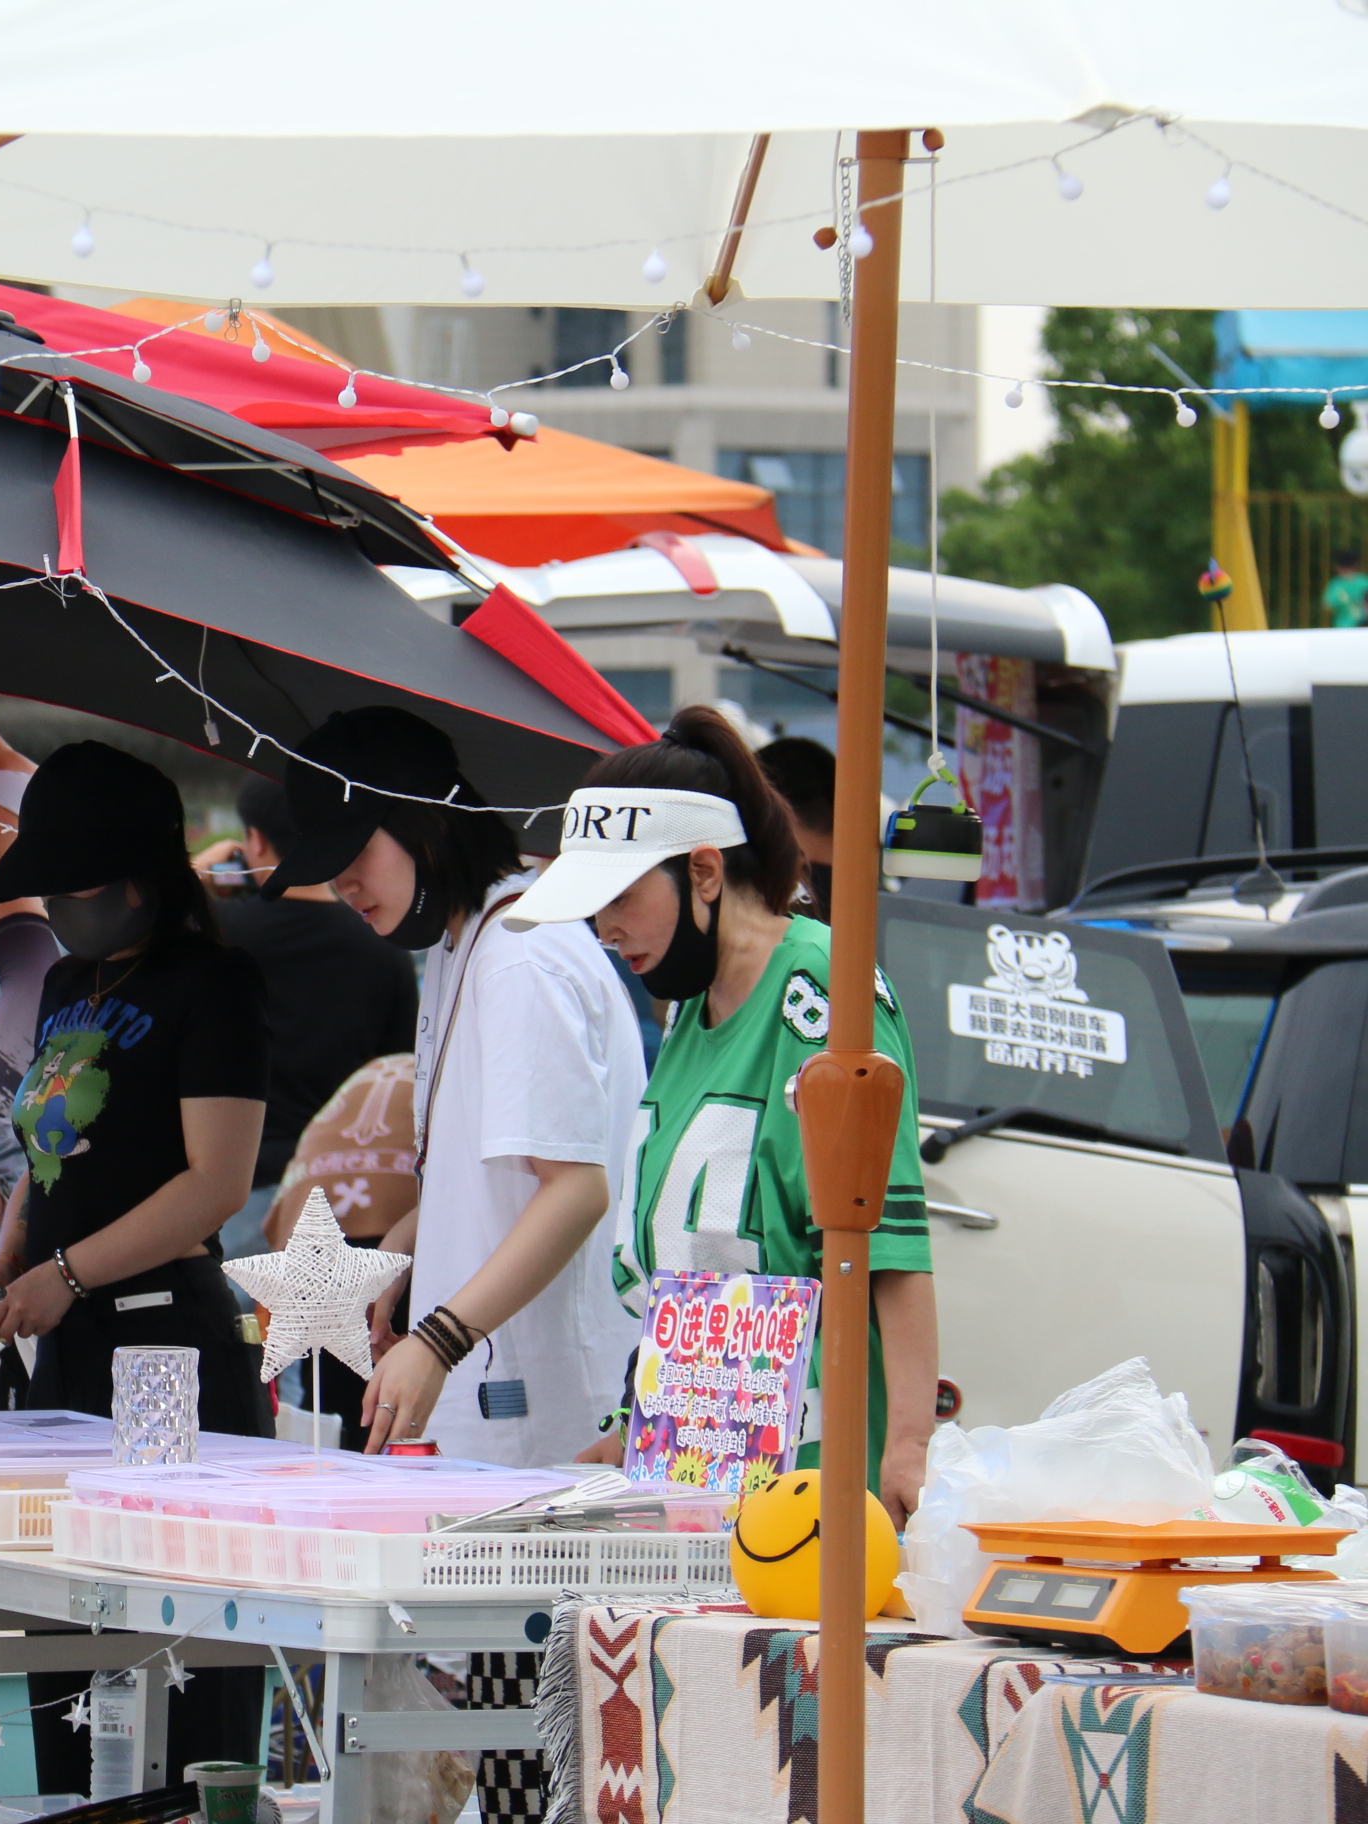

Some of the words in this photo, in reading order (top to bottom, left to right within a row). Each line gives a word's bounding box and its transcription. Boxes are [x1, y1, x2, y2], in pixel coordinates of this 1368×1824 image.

[563, 805, 652, 841] ORT
[39, 998, 153, 1049] TORONTO
[969, 994, 1107, 1034] 后面大哥别超车
[654, 1297, 801, 1362] 自选果汁QQ糖
